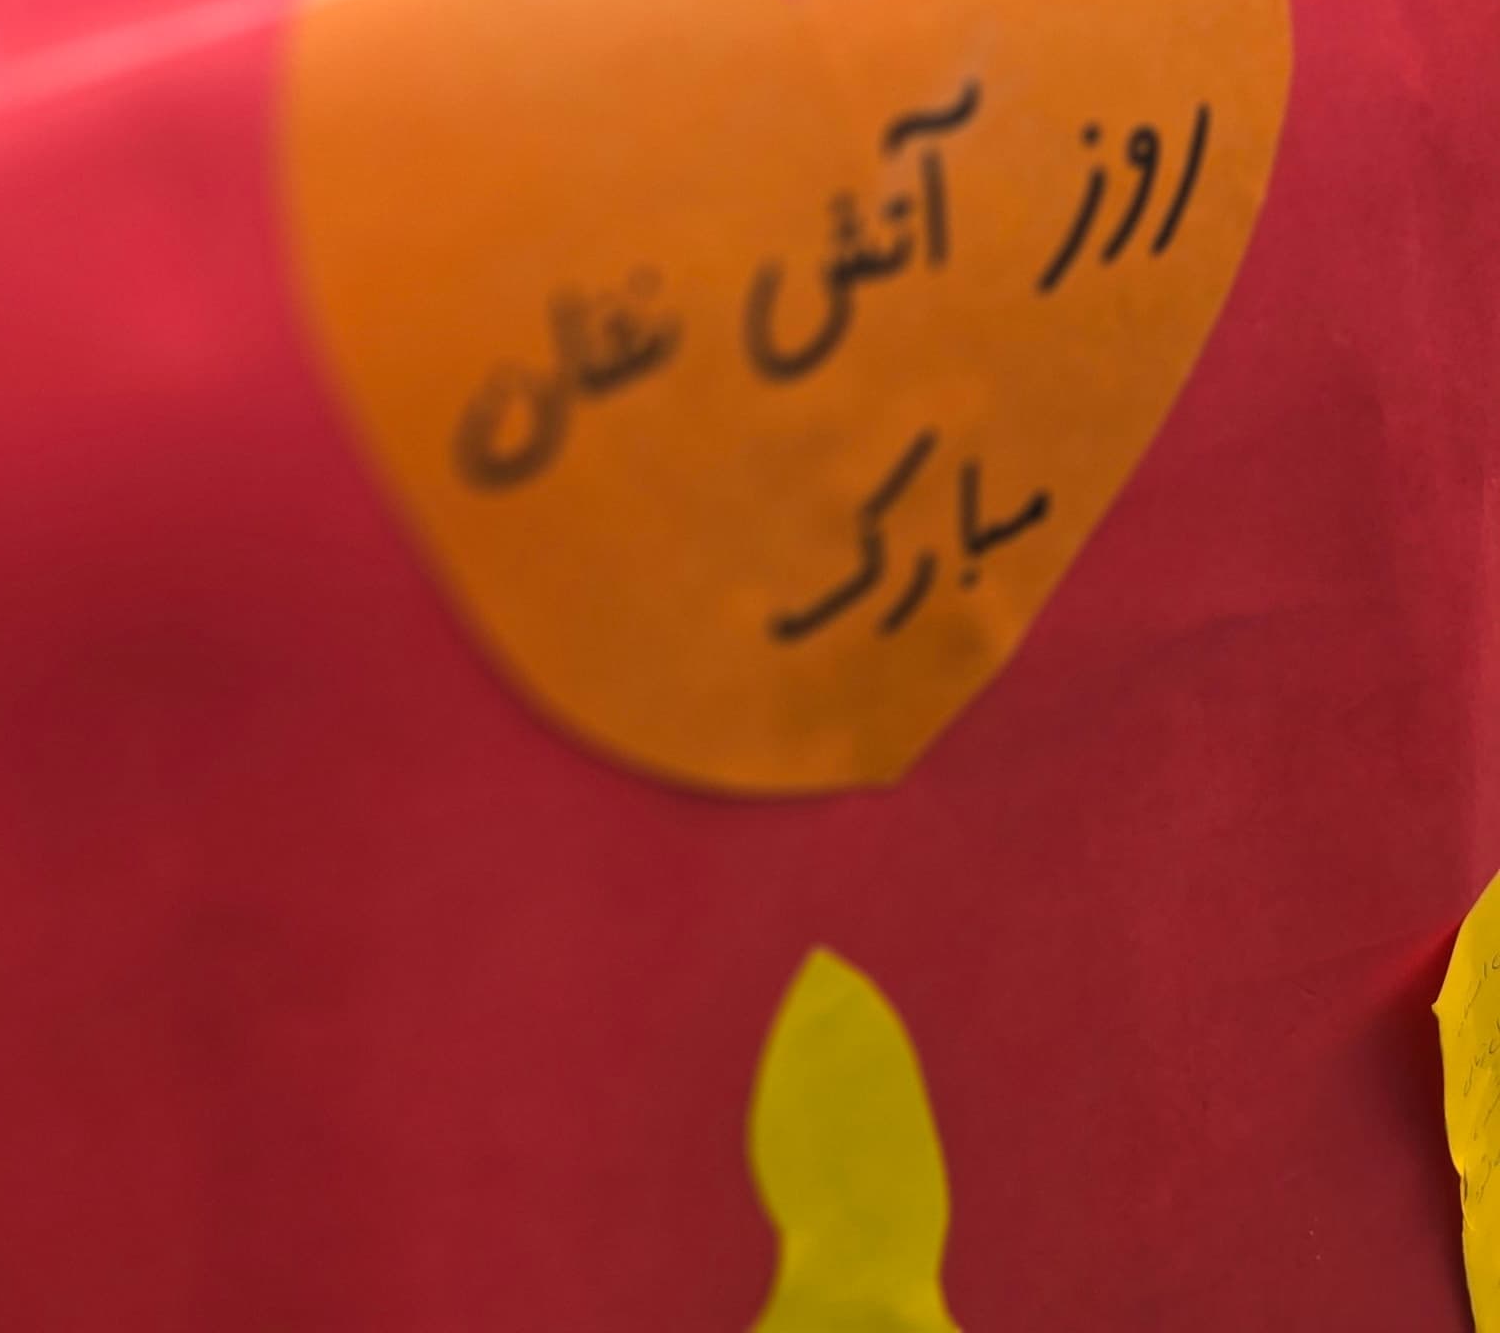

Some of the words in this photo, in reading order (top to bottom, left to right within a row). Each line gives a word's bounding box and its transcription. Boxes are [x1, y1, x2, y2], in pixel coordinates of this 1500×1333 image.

[742, 77, 982, 385] آتش
[1037, 101, 1212, 296] روز
[769, 430, 1052, 643] مبارک
